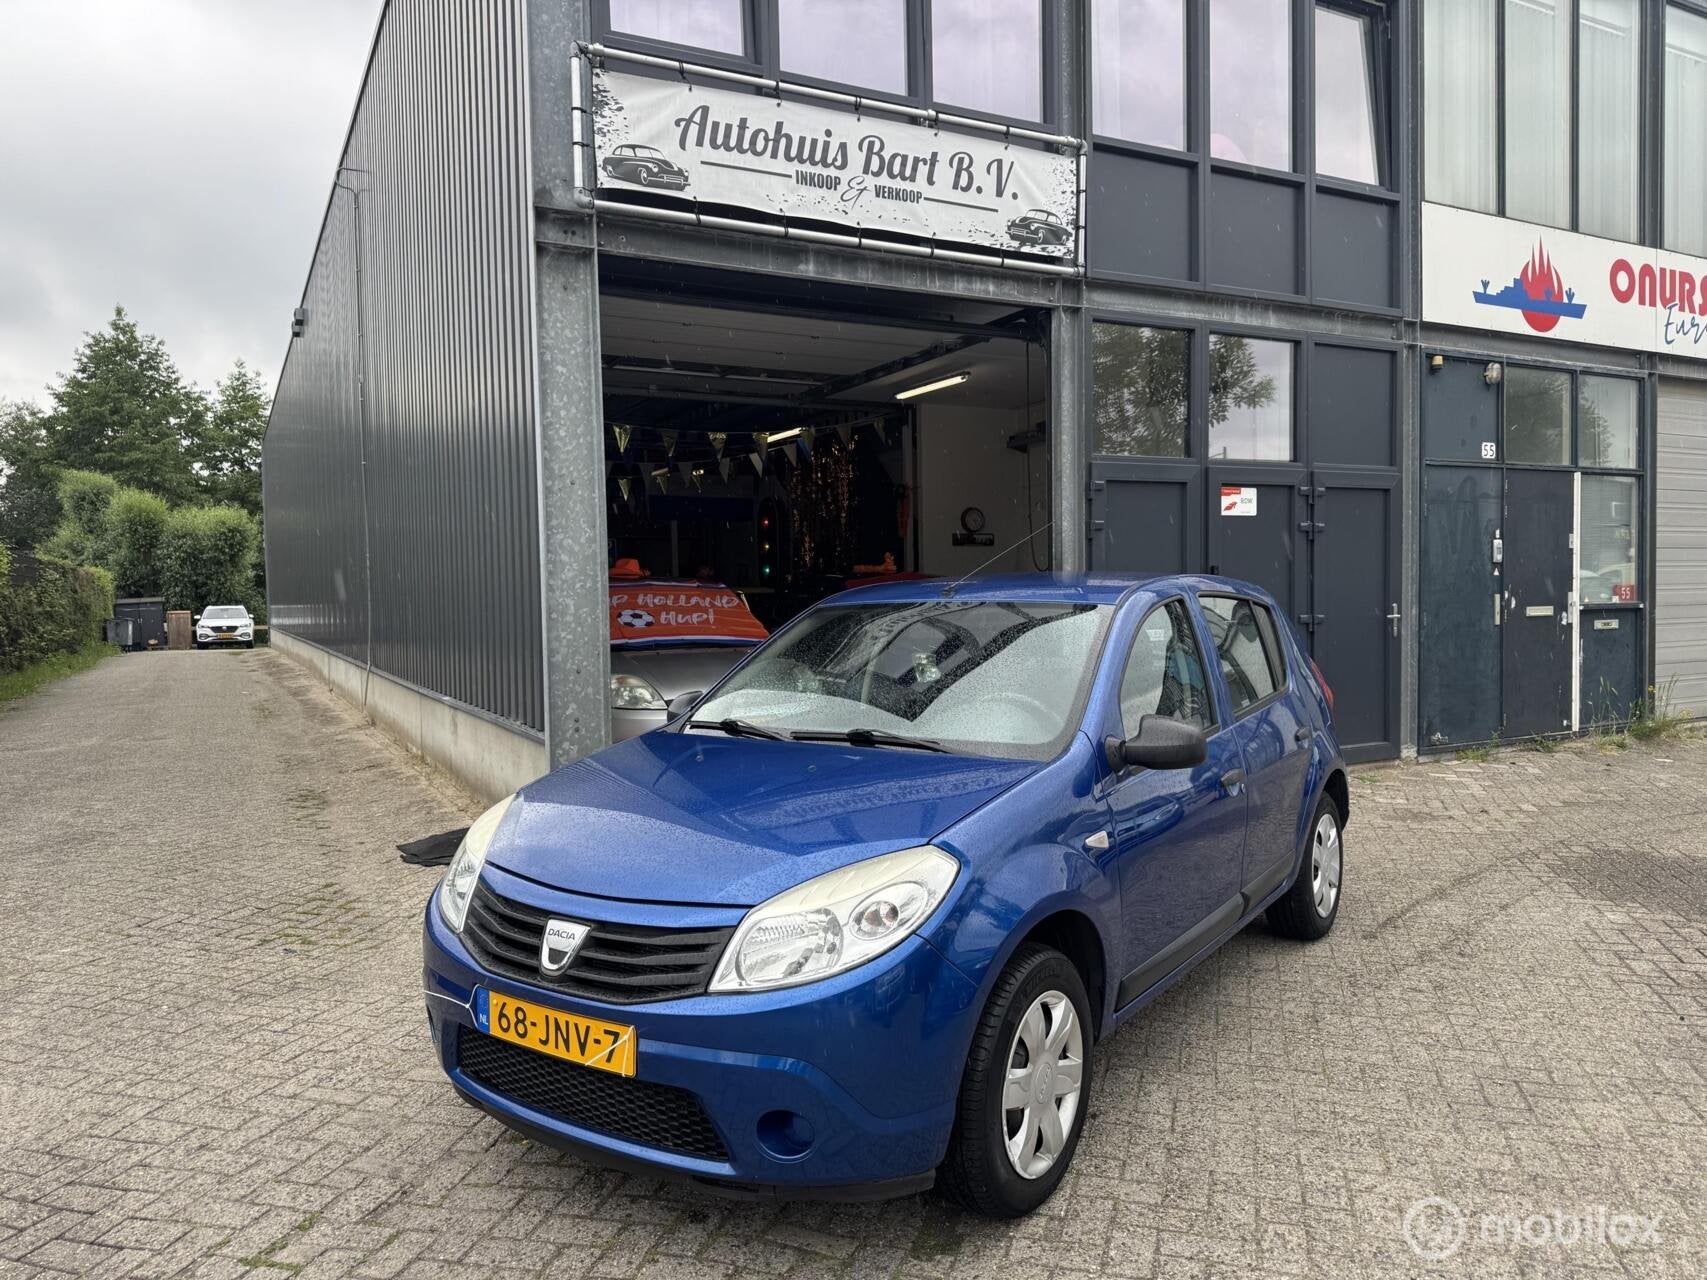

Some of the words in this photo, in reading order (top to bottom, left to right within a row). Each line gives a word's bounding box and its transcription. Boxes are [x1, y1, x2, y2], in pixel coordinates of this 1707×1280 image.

[674, 104, 848, 171] Autohuis
[857, 134, 940, 186] Bart
[795, 169, 841, 191] INKOOP
[840, 175, 872, 211] &
[874, 184, 923, 204] VERKOOP
[1664, 303, 1707, 345] Eur
[1483, 444, 1495, 457] 55
[609, 594, 628, 608] P
[637, 593, 739, 608] HOLLAND
[1621, 587, 1631, 599] 55
[547, 928, 575, 940] DACIA
[480, 1013, 489, 1025] NL
[498, 1002, 620, 1063] 68-JNV-7
